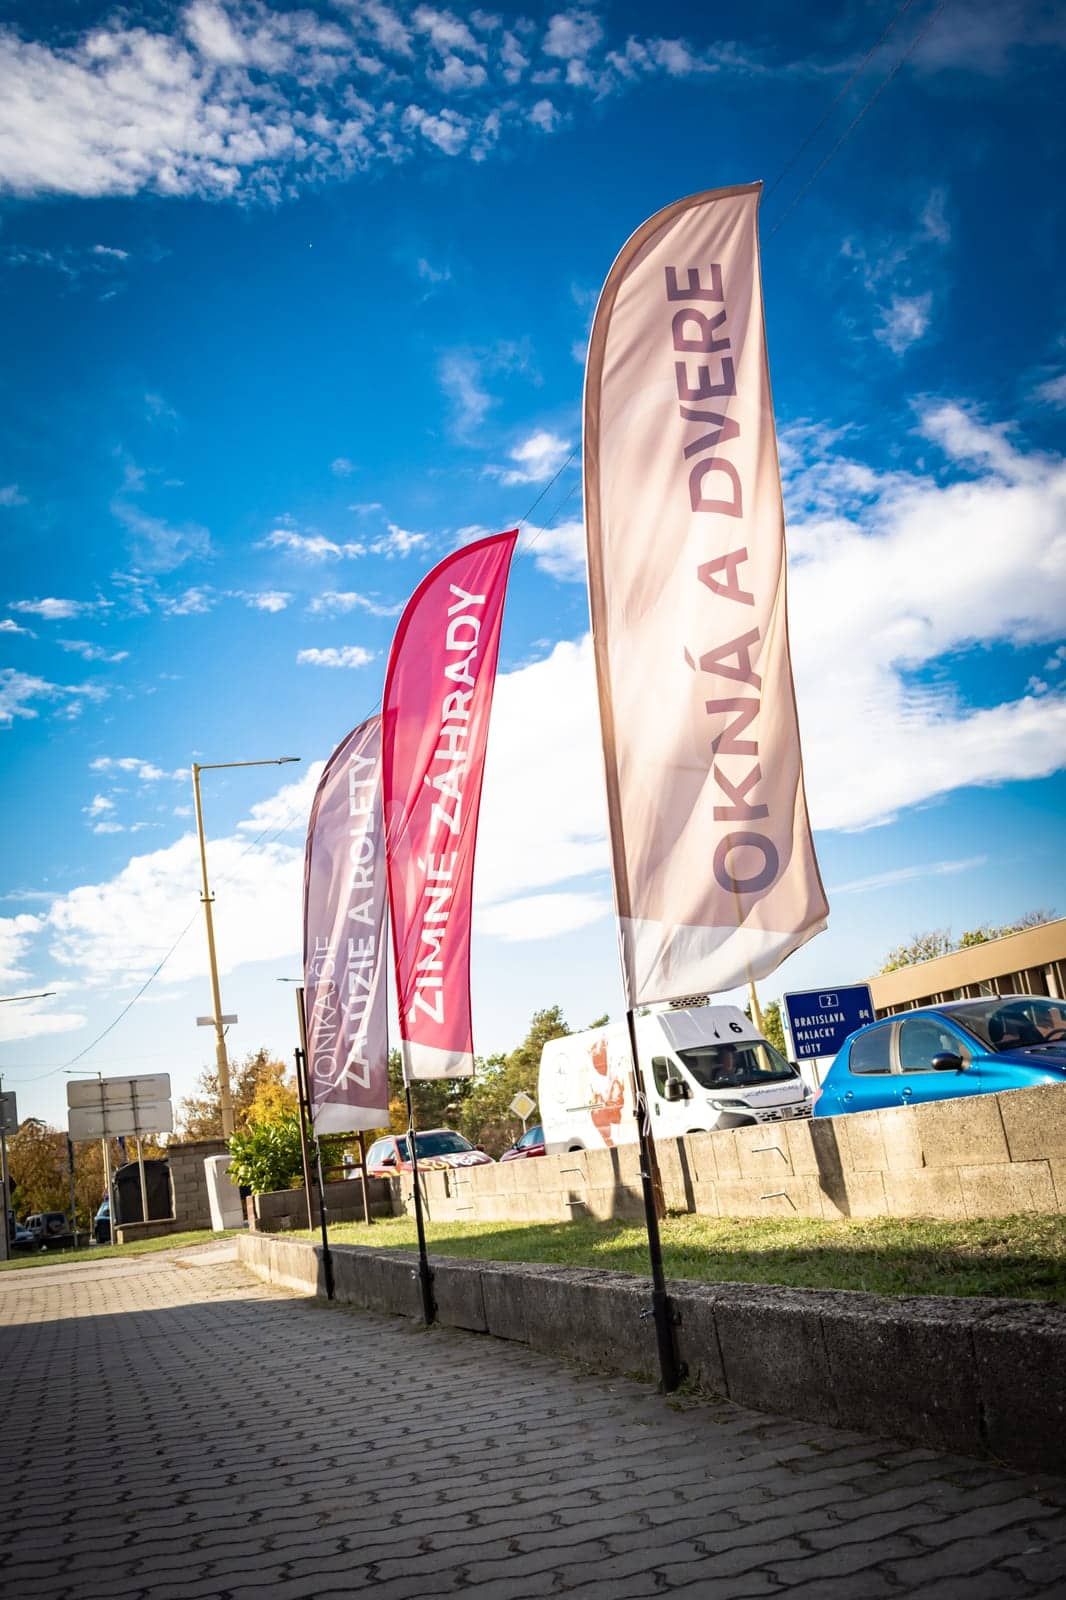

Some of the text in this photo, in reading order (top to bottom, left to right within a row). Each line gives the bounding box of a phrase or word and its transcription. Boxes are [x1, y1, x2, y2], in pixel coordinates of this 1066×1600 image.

[664, 263, 779, 895] OKNÁ A DVERE
[408, 583, 486, 1024] ZIMNÉ ZÁHRADY
[348, 753, 377, 889] ROLETY
[348, 896, 375, 926] A
[826, 996, 833, 1006] 2
[309, 936, 337, 1100] VONKAJŠIE
[729, 1022, 743, 1034] 6
[794, 1012, 846, 1028] BRATISLAVA
[797, 1027, 835, 1041] MALACKY
[800, 1042, 822, 1055] KÚTY
